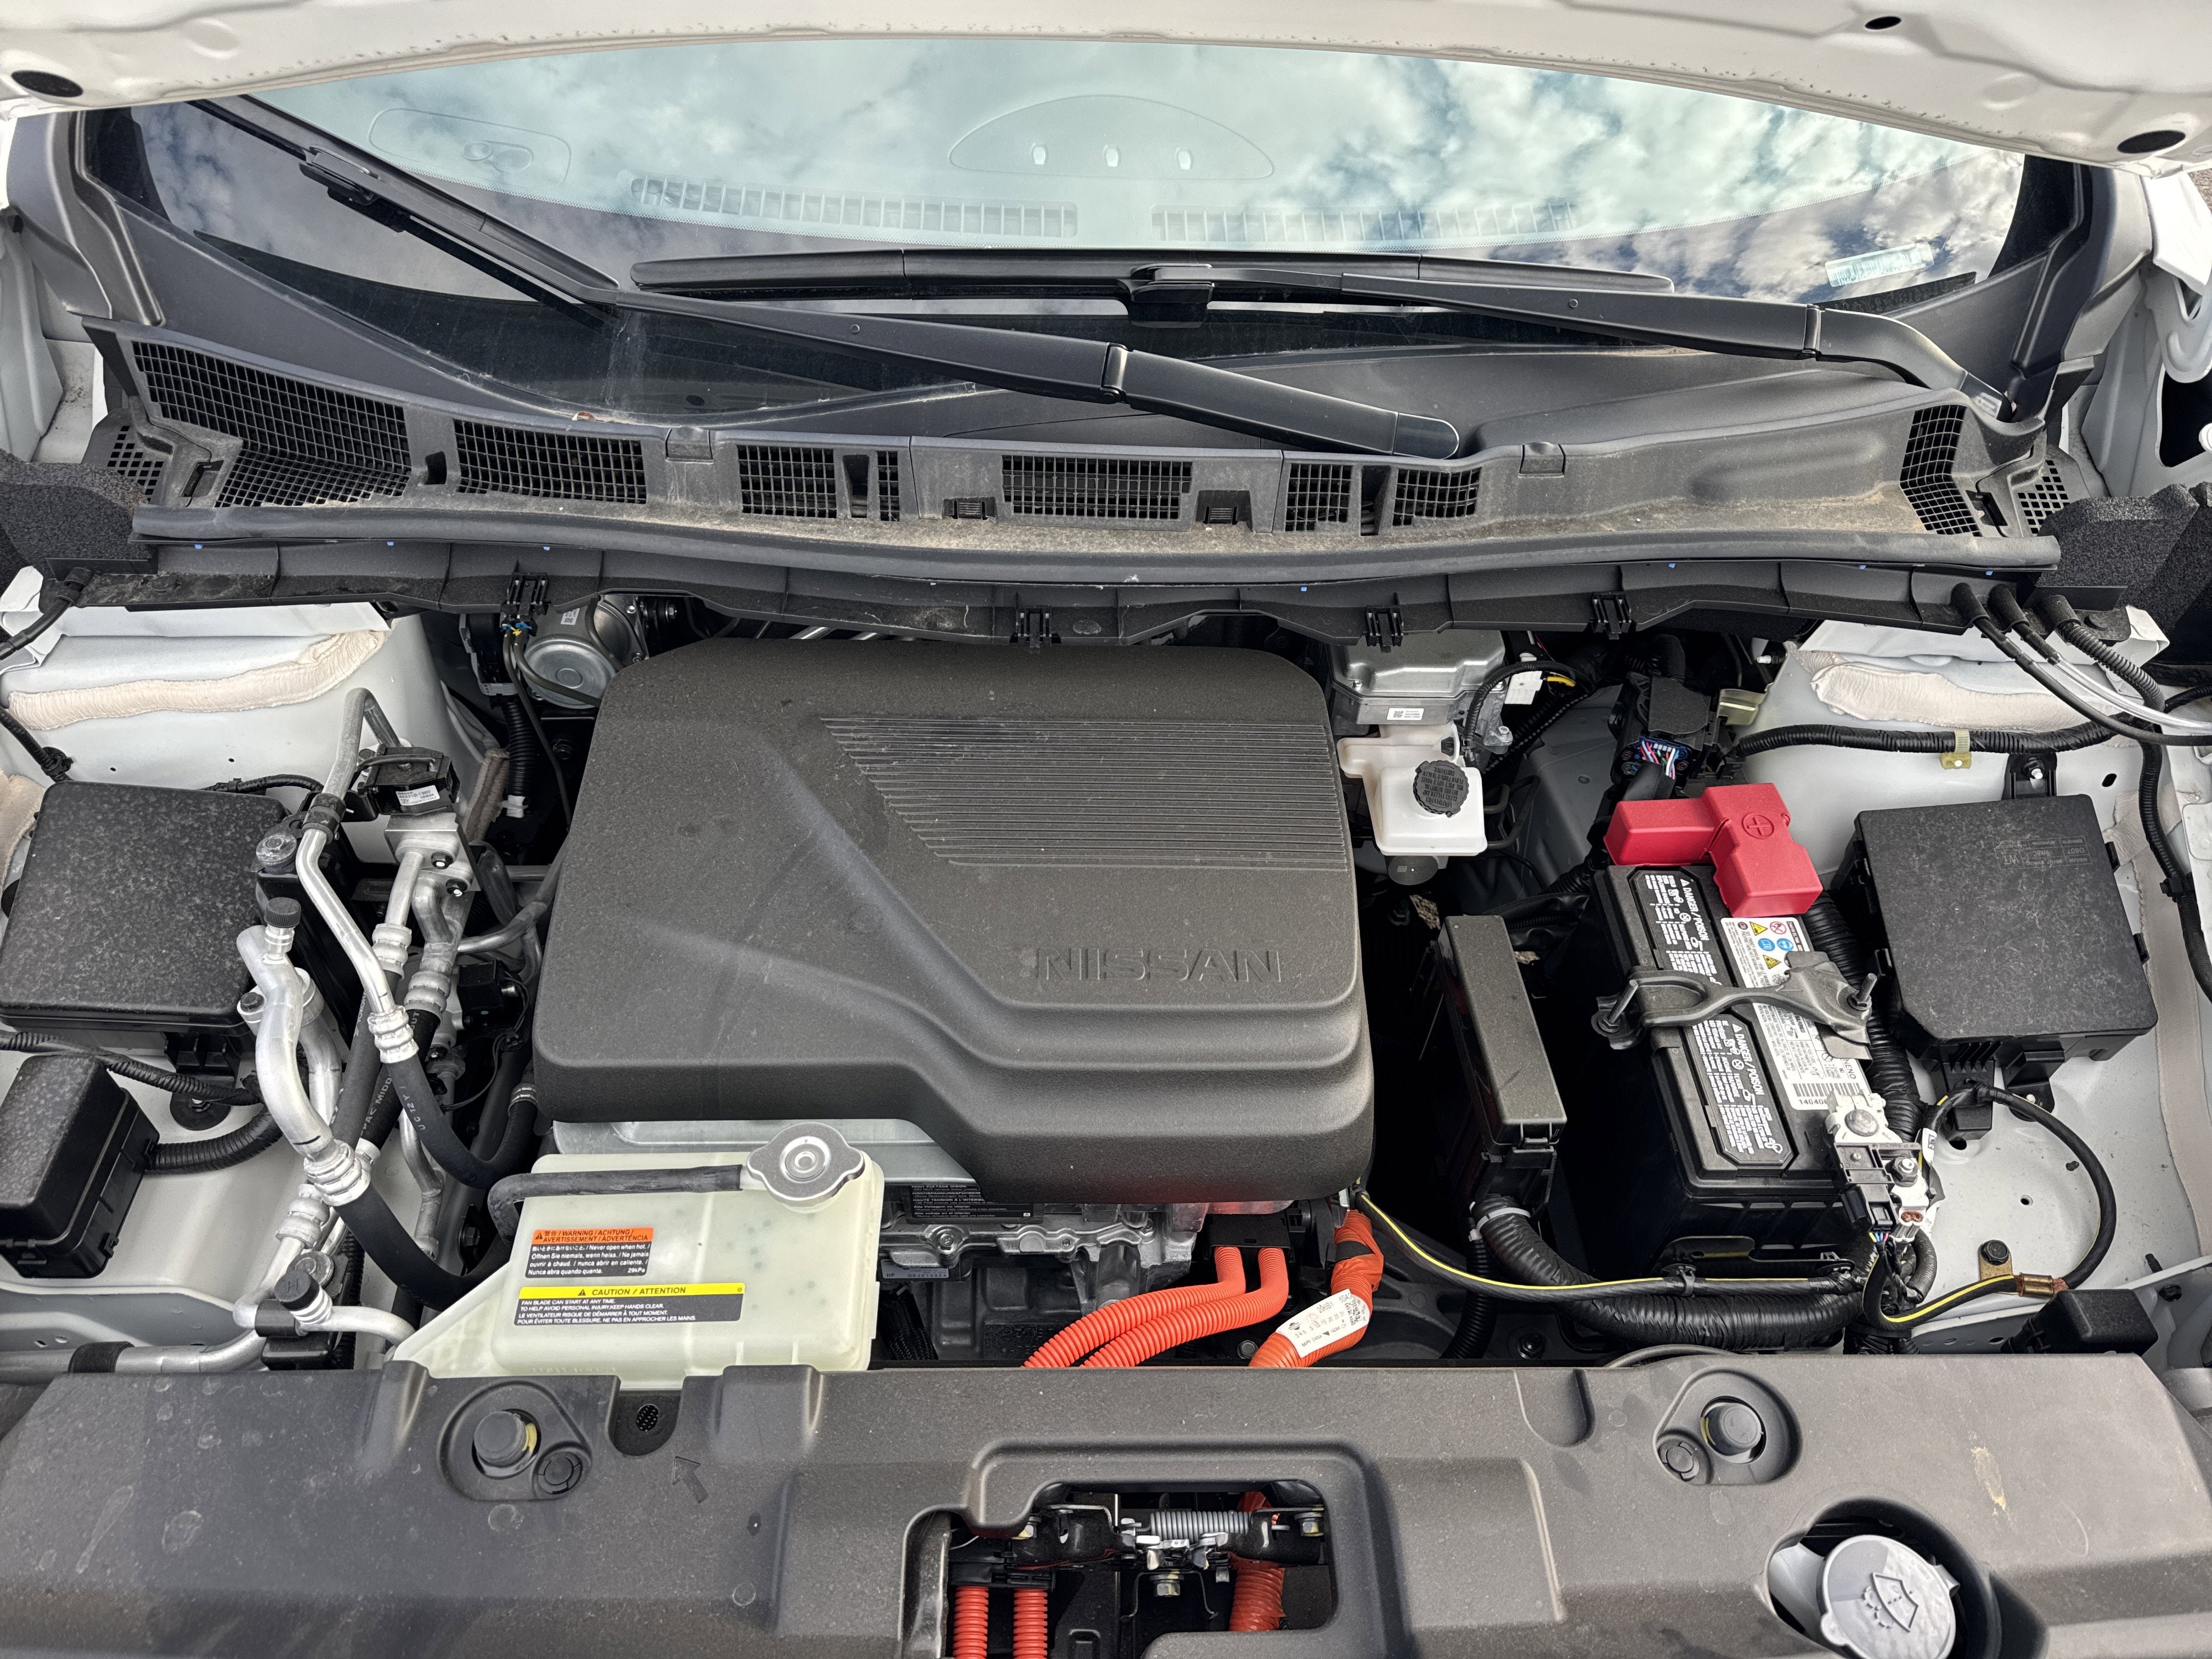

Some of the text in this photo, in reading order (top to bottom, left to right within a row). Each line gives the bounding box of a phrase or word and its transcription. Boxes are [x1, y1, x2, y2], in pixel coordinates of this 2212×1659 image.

[1036, 947, 1281, 983] NISSAN
[1842, 1058, 1857, 1079] NENO
[375, 1077, 392, 1104] MIDD
[287, 1278, 298, 1293] H
